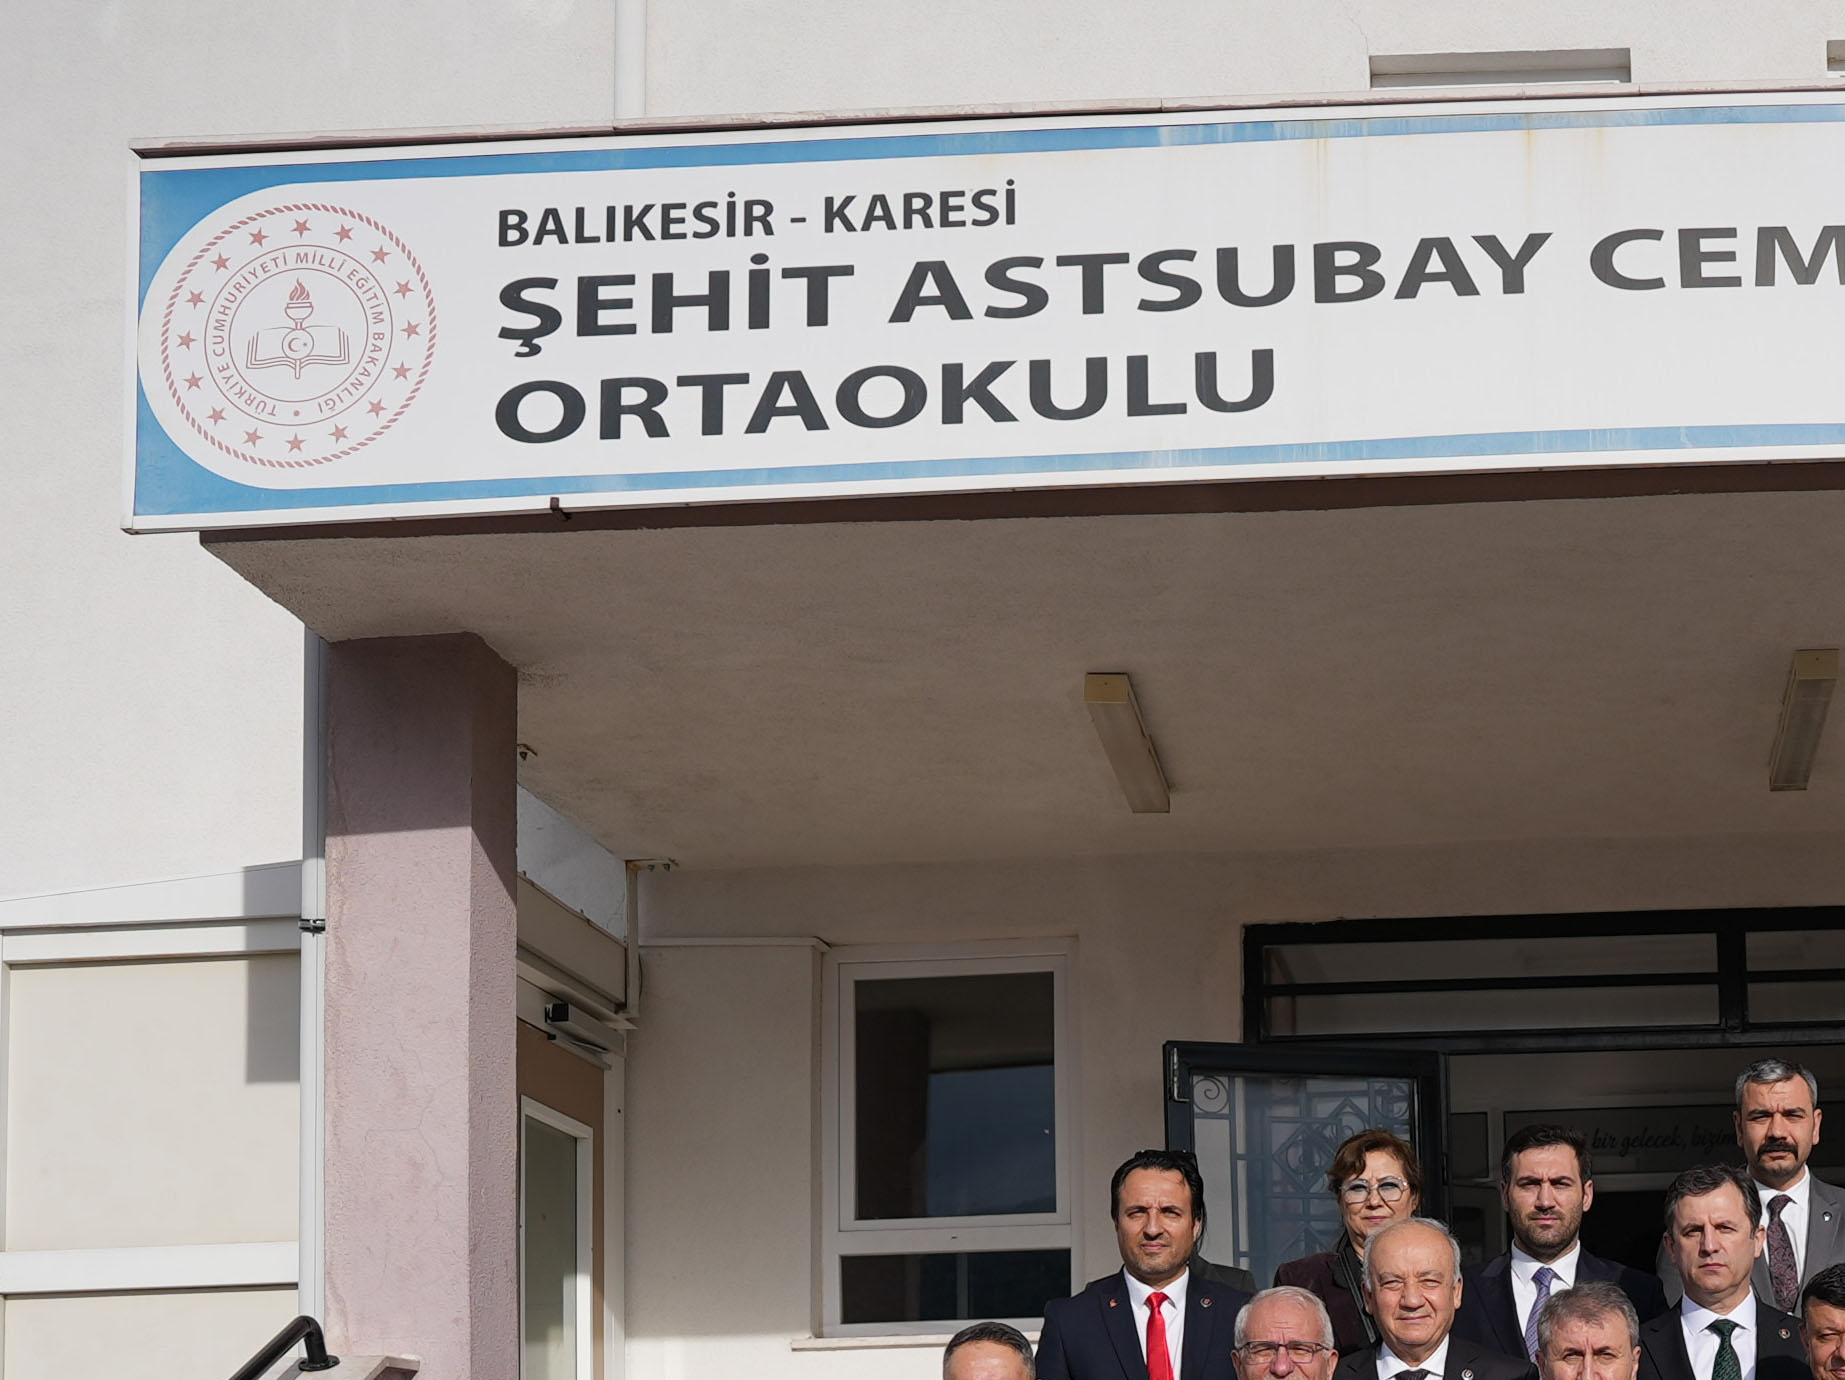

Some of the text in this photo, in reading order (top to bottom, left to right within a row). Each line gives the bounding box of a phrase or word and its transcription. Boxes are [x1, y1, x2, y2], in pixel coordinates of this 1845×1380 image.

[498, 191, 775, 248] BALIKESİR
[824, 178, 1017, 234] KARESİ
[212, 250, 386, 417] TÜRKİYE CUMHURİYETİ MİLLİ EĞİTİM BAKANLIĞI
[497, 252, 855, 358] ŞEHİT
[887, 232, 1554, 323] ASTSUBAY
[495, 348, 1275, 444] ORTAOKULU
